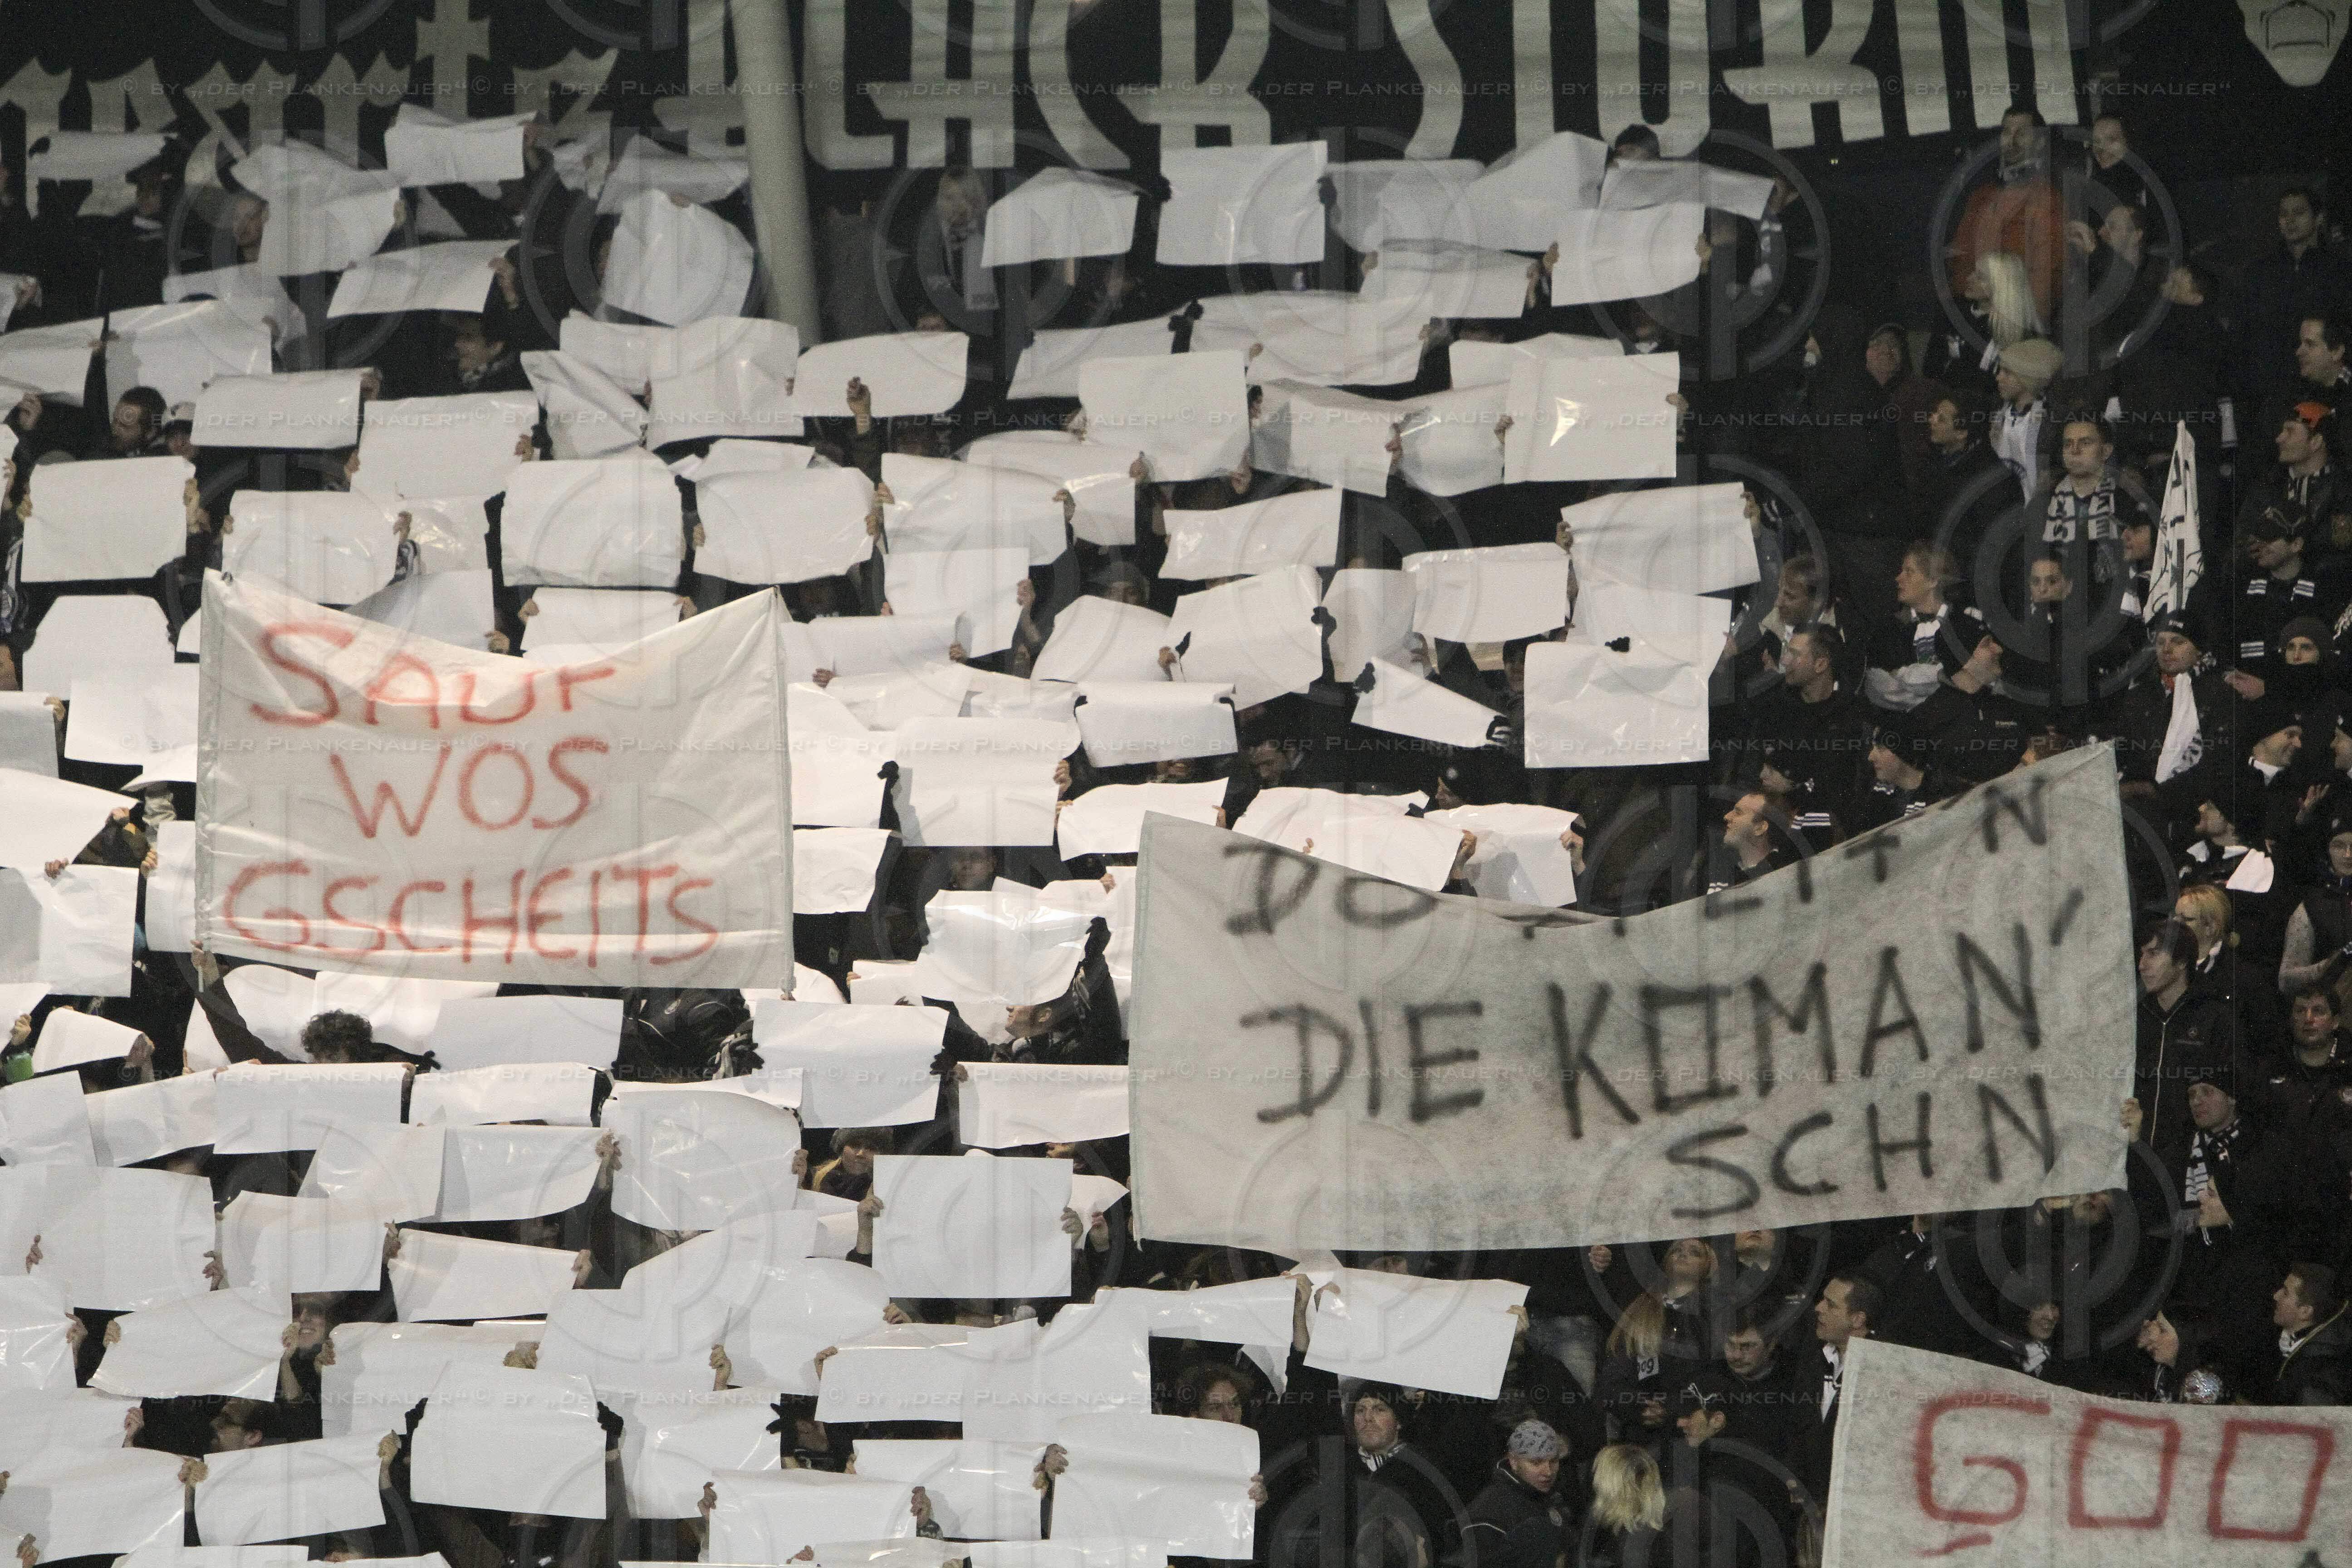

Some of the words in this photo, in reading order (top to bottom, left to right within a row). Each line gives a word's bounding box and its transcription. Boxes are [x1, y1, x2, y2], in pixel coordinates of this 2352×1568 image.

[330, 736, 609, 838] WOS
[221, 859, 720, 966] GSCHEITS
[1238, 1000, 1484, 1125] DIE
[1666, 1073, 2055, 1219] SCHN
